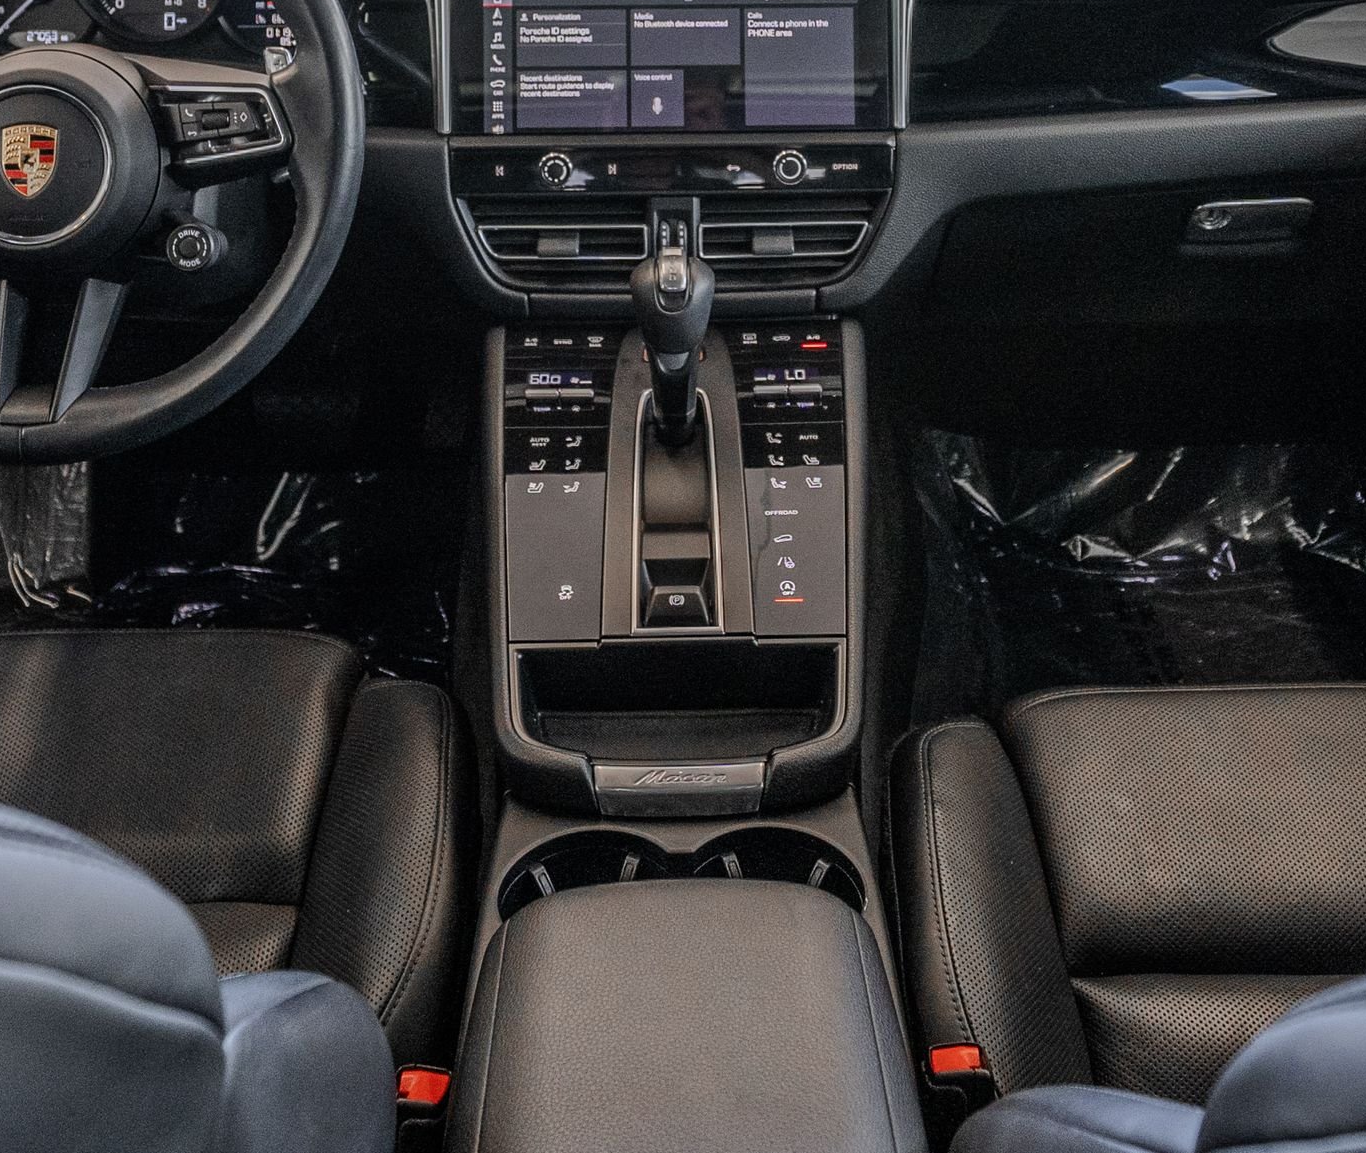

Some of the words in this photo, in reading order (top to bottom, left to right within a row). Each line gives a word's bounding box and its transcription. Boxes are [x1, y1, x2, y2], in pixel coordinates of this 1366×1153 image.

[533, 13, 581, 21] Personalization
[634, 12, 654, 20] Media
[674, 19, 695, 27] device
[695, 19, 729, 27] connected
[785, 19, 807, 28] phone
[808, 19, 816, 27] in
[816, 19, 829, 27] the
[520, 27, 550, 35] Porsche
[551, 27, 559, 35] ID
[560, 27, 590, 36] settings
[747, 29, 775, 37] PHONE
[530, 35, 556, 43] Porsche
[565, 35, 593, 44] assigned
[520, 74, 543, 82] Recent
[543, 74, 583, 82] destinations
[634, 73, 650, 81] Voice
[650, 73, 672, 81] control
[556, 82, 584, 90] guidance
[593, 82, 614, 90] display
[178, 229, 200, 239] DRIVE
[179, 258, 201, 267] MODE
[784, 369, 806, 380] LO
[635, 770, 727, 785] Macan
